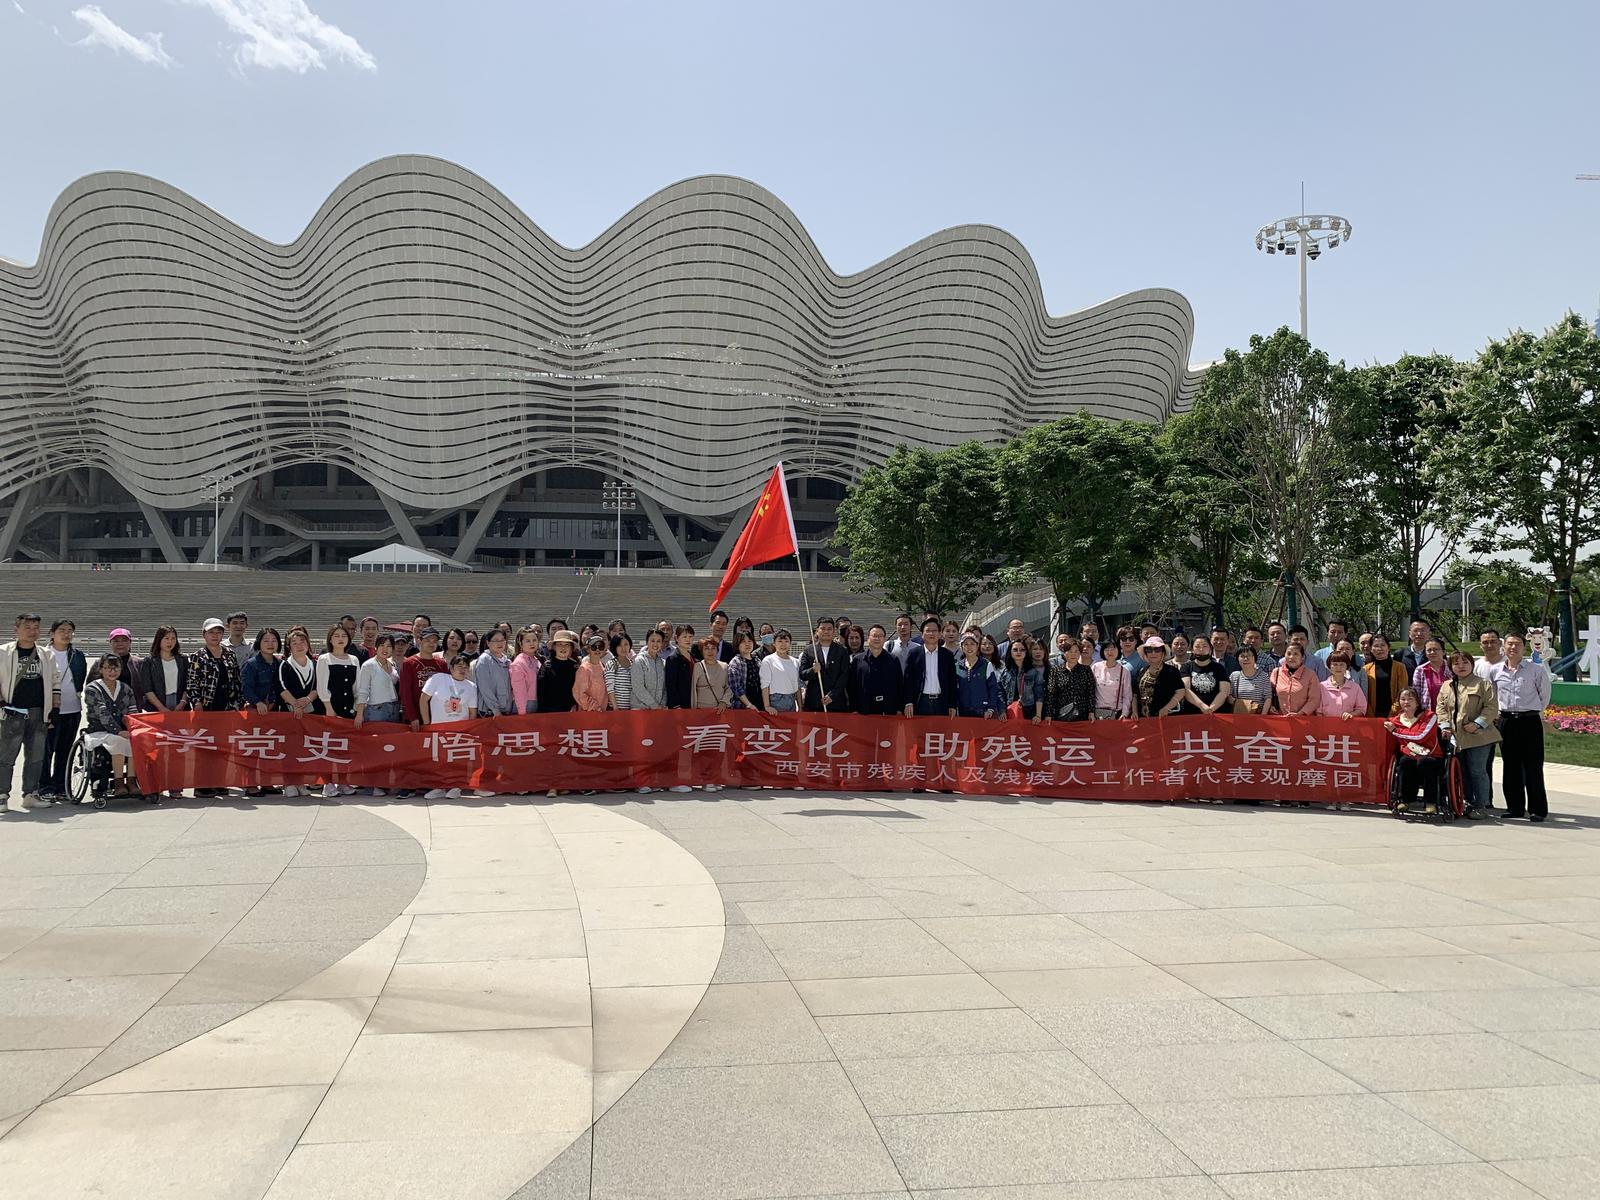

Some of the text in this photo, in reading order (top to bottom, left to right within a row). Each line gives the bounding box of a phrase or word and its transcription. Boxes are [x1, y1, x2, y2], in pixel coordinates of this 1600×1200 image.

[774, 759, 1363, 788] 西安市残疾人及残疾人工作者代表观摩团
